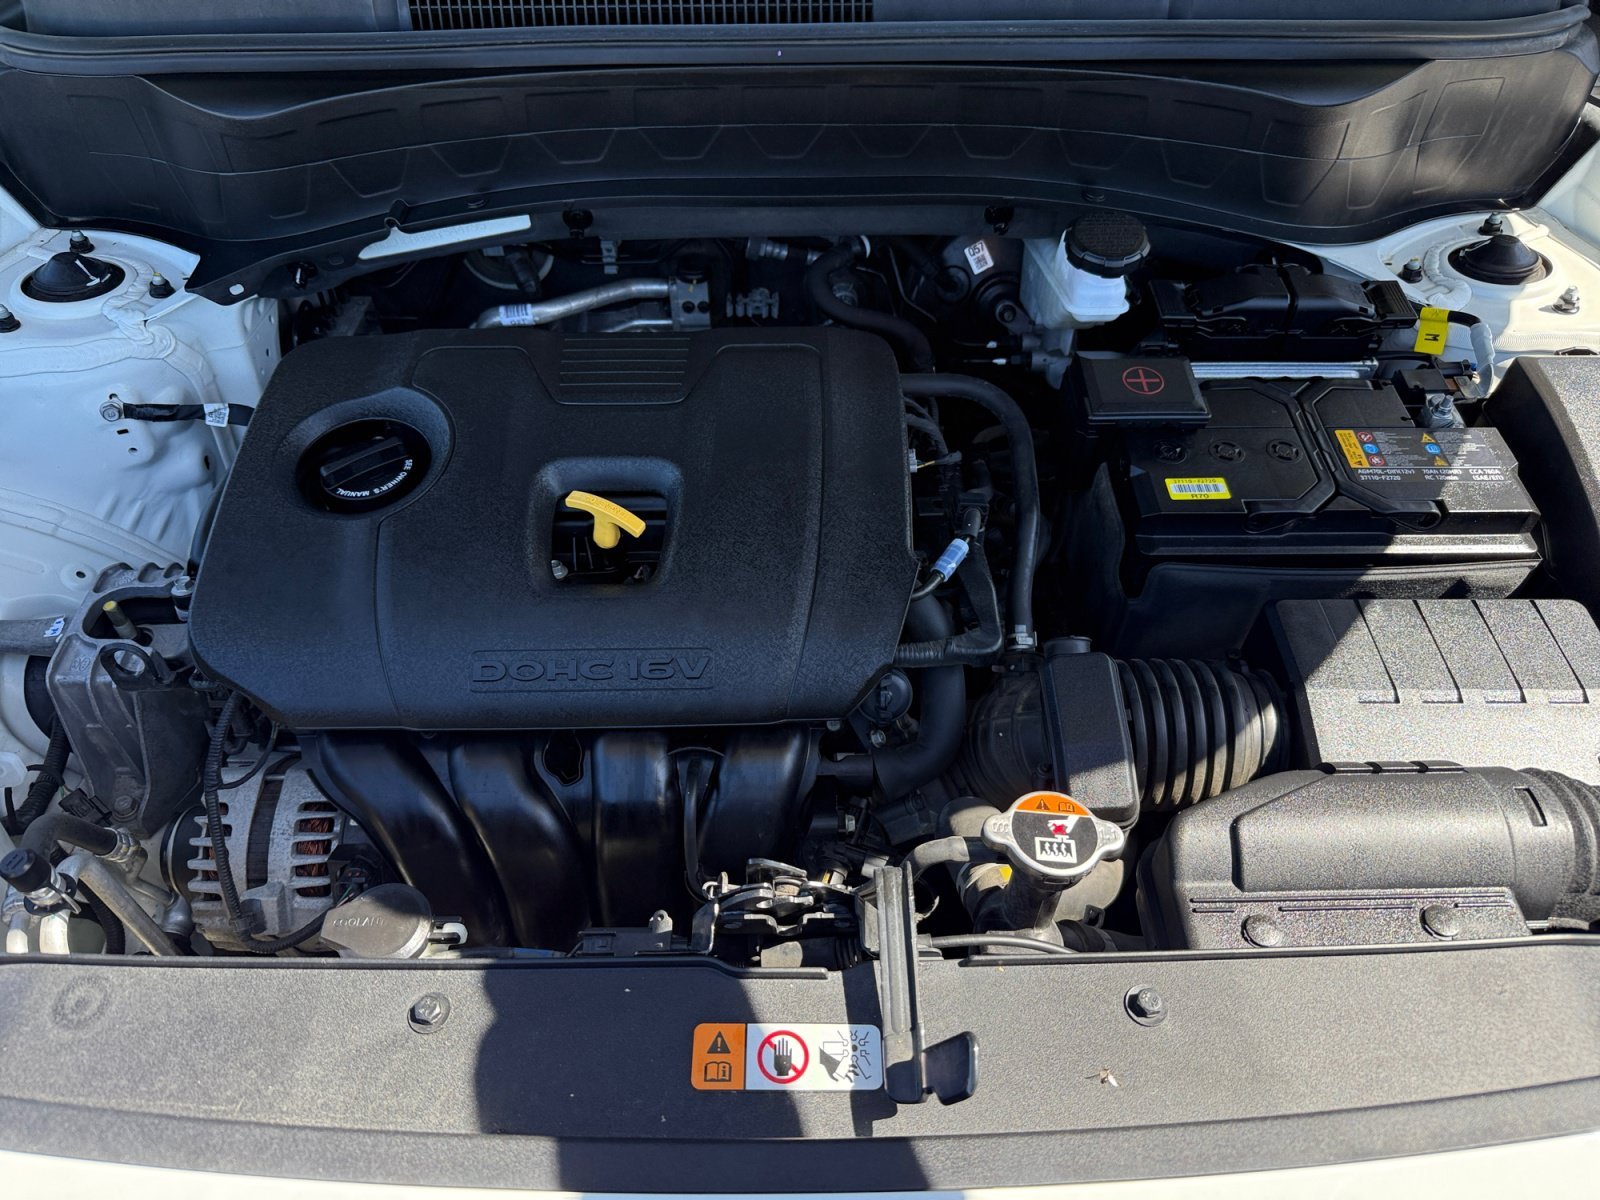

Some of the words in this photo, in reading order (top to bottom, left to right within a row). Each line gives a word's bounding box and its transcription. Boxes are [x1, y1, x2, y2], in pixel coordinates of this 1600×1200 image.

[402, 458, 413, 471] SEE
[372, 471, 408, 494] OWNER'S
[335, 487, 370, 497] MANUAL
[472, 656, 615, 683] DOHC
[628, 655, 712, 681] 16V
